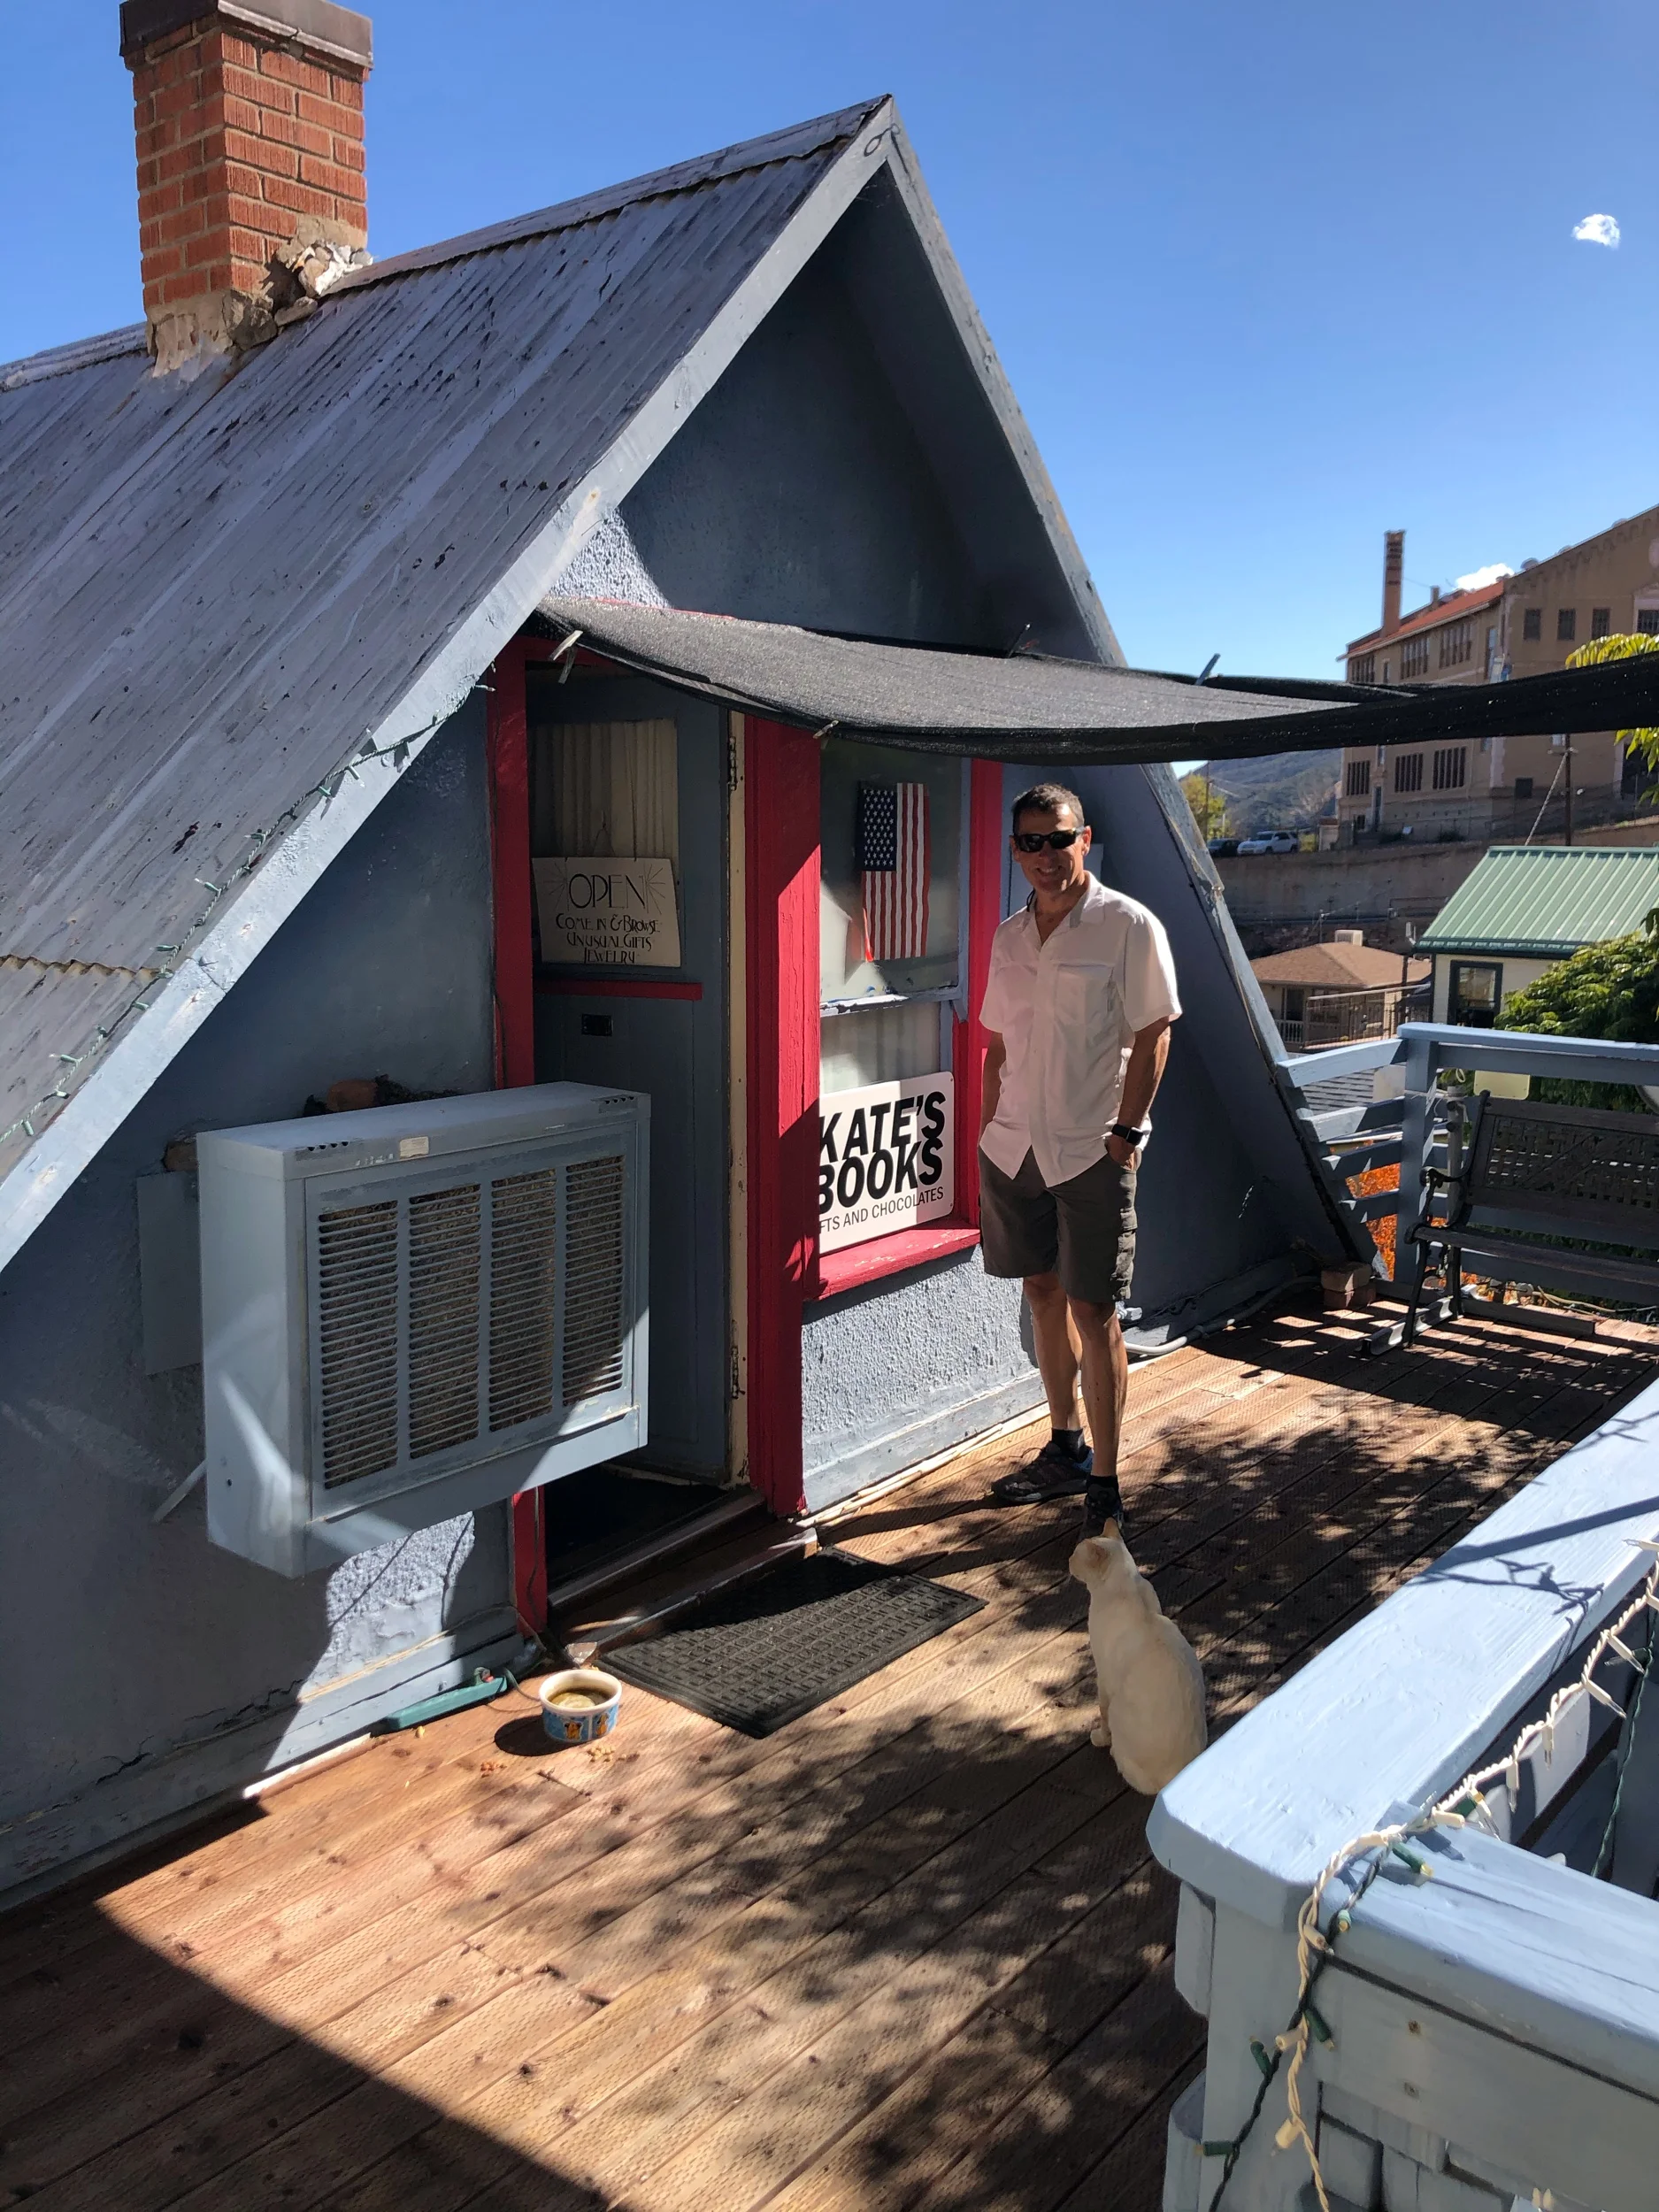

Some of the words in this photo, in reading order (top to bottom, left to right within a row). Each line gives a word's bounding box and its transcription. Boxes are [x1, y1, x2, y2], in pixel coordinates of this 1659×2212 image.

[569, 873, 646, 909] OPEN
[556, 913, 593, 931] COME
[596, 918, 607, 931] IN
[623, 914, 660, 934] BROWSE
[566, 932, 623, 949] UNUSUAL
[624, 933, 652, 951] GIFTS
[584, 947, 635, 964] JEWELRY
[819, 1091, 946, 1164] KATE'S
[819, 1137, 943, 1215] BOOKS
[819, 1216, 841, 1234] FTS
[843, 1208, 868, 1227] AND
[872, 1187, 944, 1218] CHOCOLATES
